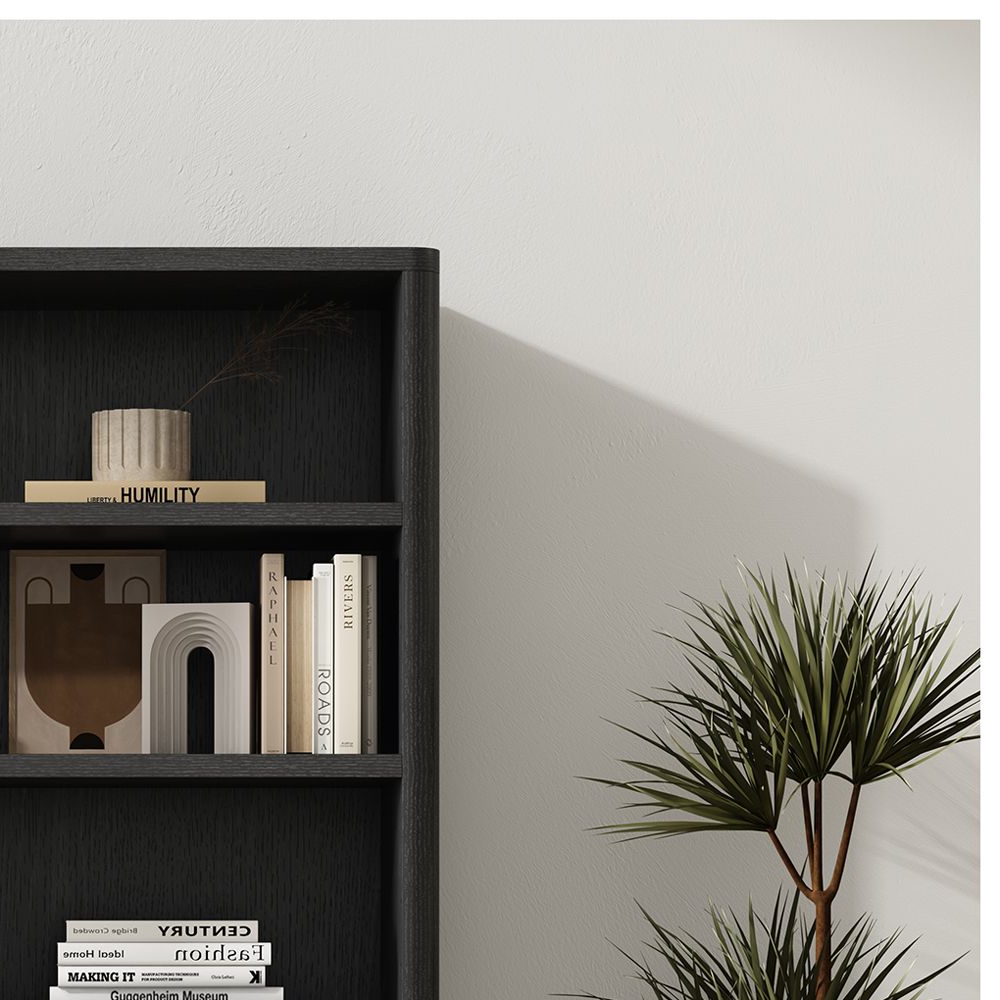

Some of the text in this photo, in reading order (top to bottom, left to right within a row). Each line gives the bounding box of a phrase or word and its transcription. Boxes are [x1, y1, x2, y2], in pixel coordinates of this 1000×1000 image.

[121, 487, 200, 503] HUMILITY
[268, 571, 278, 665] RAPHAEL
[344, 574, 354, 629] RIVERS
[318, 668, 331, 736] ROADS
[67, 972, 135, 982] MAKING IT
